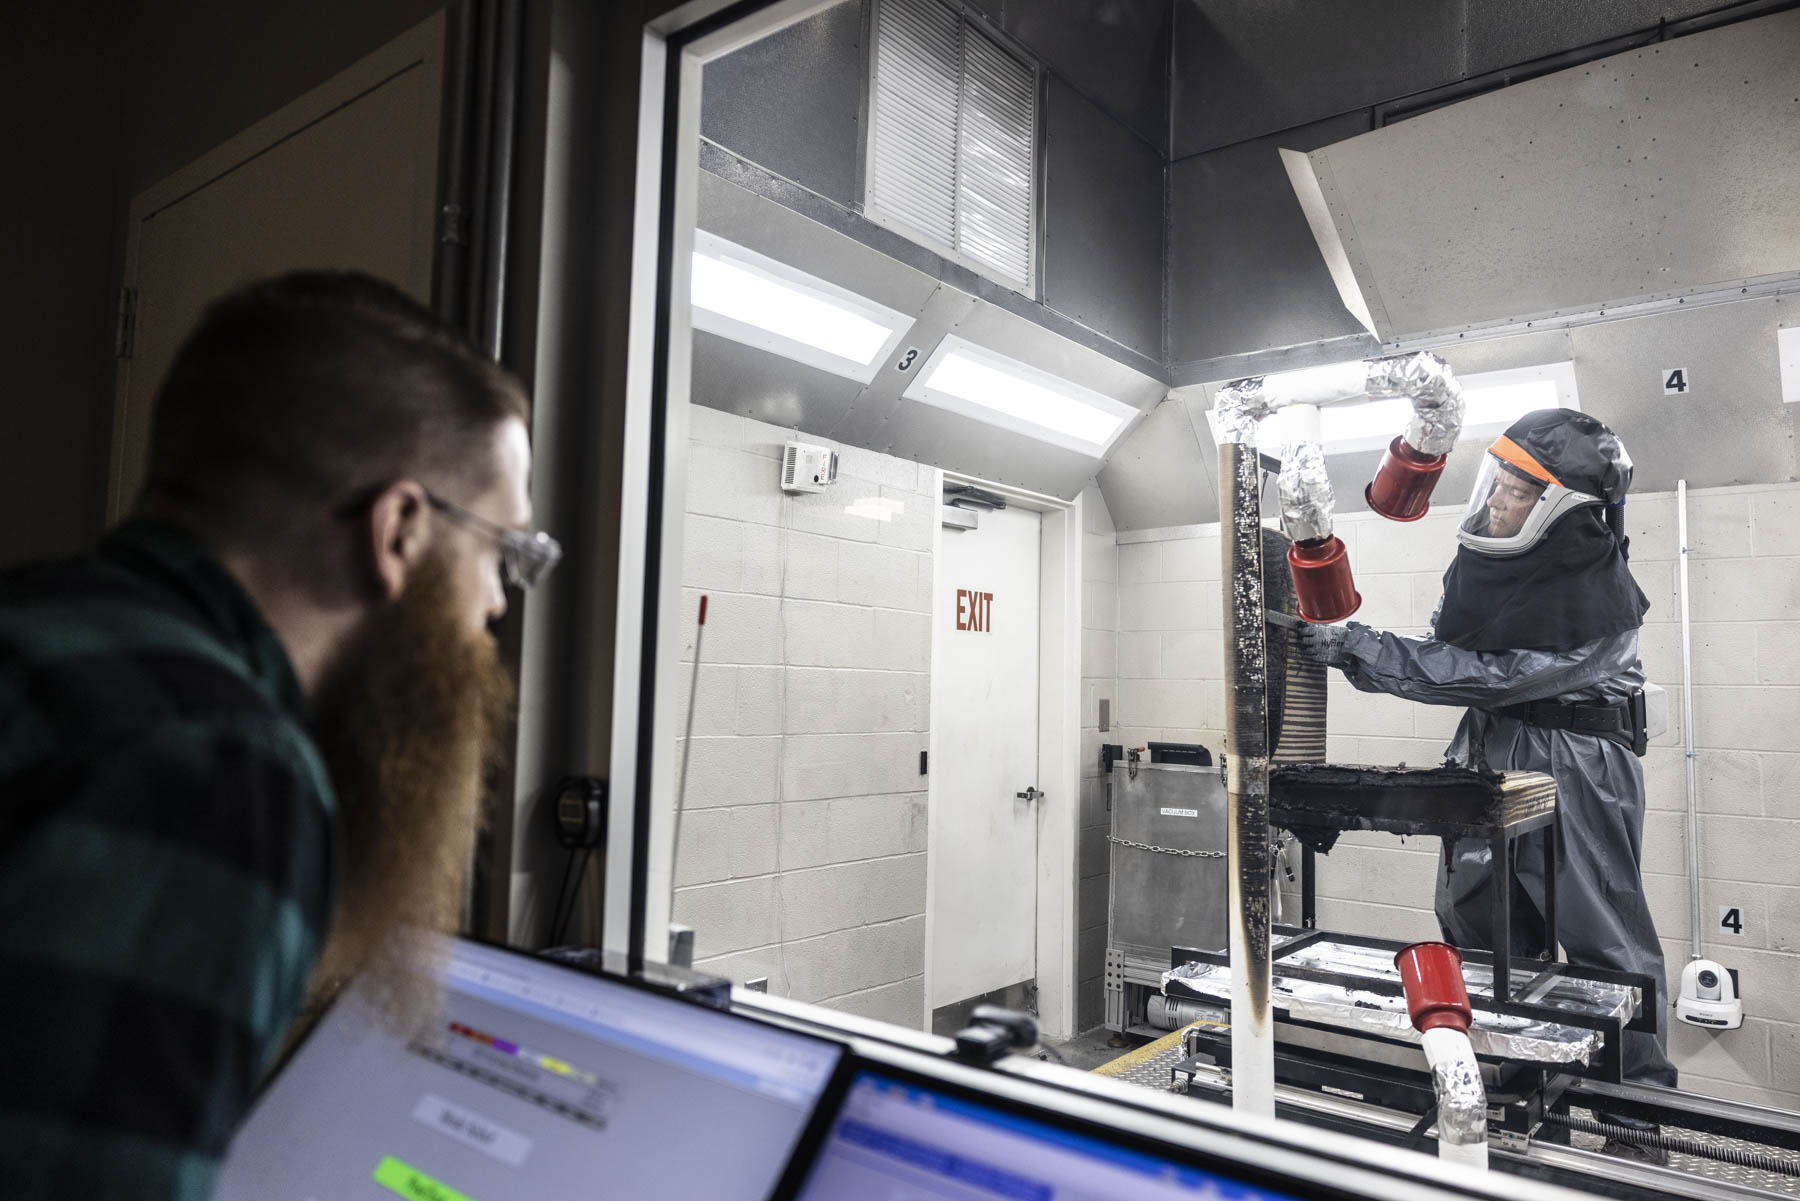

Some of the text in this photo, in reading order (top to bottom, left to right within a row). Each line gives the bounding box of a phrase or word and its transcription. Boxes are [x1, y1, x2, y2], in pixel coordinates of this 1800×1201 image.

[898, 350, 918, 370] 3
[1666, 369, 1687, 392] 4
[956, 588, 993, 632] EXIT
[1721, 908, 1742, 934] 4
